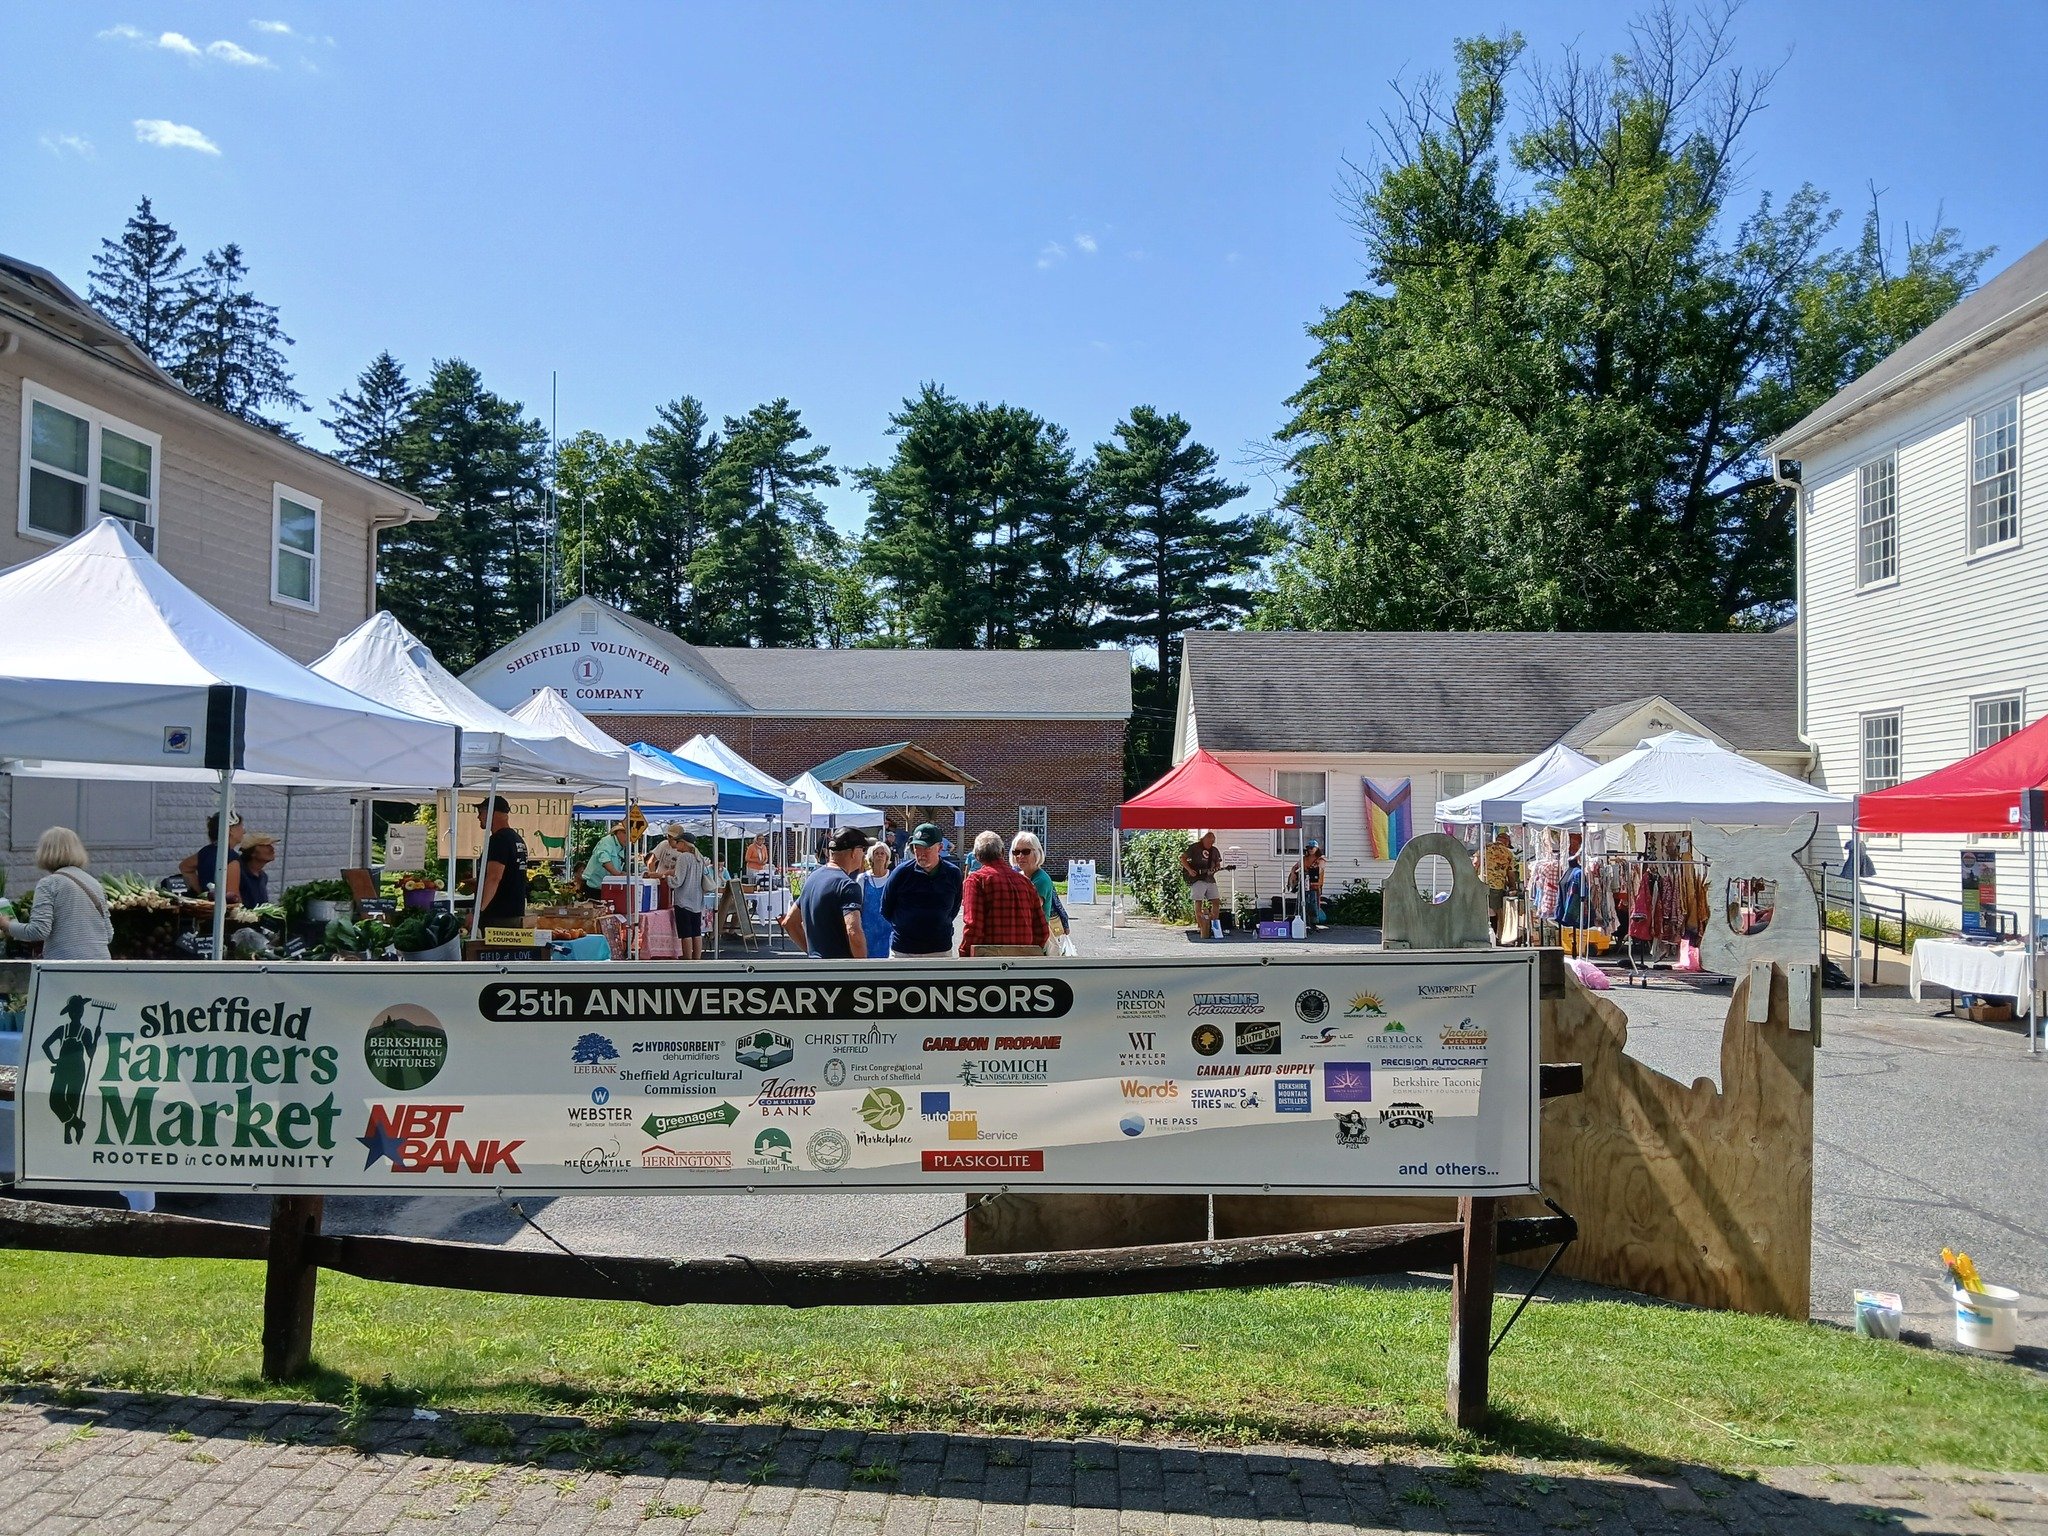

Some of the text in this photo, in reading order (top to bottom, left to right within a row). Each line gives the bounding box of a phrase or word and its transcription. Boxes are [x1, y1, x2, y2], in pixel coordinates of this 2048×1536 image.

[506, 641, 671, 676] SHEFFIELD VOLUNTEER
[582, 662, 592, 678] 1
[576, 688, 644, 700] COMPANY
[536, 798, 569, 816] Hill
[492, 930, 515, 938] SENIOR
[480, 952, 501, 961] FIELD
[514, 951, 532, 961] LOVE
[496, 984, 1056, 1017] 25th ANNIVERSARY SPONSORS
[1117, 990, 1165, 1000] SANDRA
[1193, 993, 1259, 1005] WATSON'S
[1117, 1000, 1166, 1010] PRESTON
[1188, 1003, 1266, 1017] Automotive
[140, 996, 312, 1042] Sheffield
[1439, 1024, 1488, 1040] Jacquier
[369, 1036, 443, 1050] BERKSHIRE
[737, 1035, 752, 1050] BIG
[774, 1034, 792, 1049] ELM
[804, 1033, 850, 1045] CHRIST
[922, 1035, 1062, 1052] CARLSON PROPANE
[1367, 1035, 1423, 1043] GREYLOCK
[370, 1047, 443, 1059] AGRICULTURAL
[832, 1046, 869, 1054] SHEFFIELD
[100, 1031, 340, 1085] Farmers
[374, 1056, 437, 1069] VENTURES
[662, 1053, 720, 1062] dehumidifiers
[1381, 1058, 1488, 1066] PRECISION AUTOCRAFT
[574, 1065, 617, 1075] LEE BANK
[869, 1063, 923, 1073] Congregational
[978, 1060, 1048, 1073] TOMICH
[1197, 1063, 1316, 1076] CANAAN AUTO SUPPLY
[619, 1069, 743, 1083] Sheffield Agricultural
[853, 1072, 921, 1082] Church of Sheffield
[980, 1073, 1047, 1081] LANDSCAPE DESIGN
[1392, 1076, 1481, 1087] Berkshire Taconic
[644, 1084, 717, 1095] Commission
[749, 1077, 817, 1105] Adams
[1120, 1079, 1179, 1098] Ward's
[1191, 1088, 1247, 1098] SEWARD'S
[594, 1091, 607, 1103] W
[1278, 1097, 1308, 1105] DISTILLERS
[1191, 1099, 1222, 1109] TIRES
[94, 1085, 342, 1150] Market
[567, 1108, 633, 1121] WEBSTER
[762, 1106, 812, 1117] BANK
[921, 1110, 978, 1122] autobahn
[1379, 1109, 1434, 1125] MAHAIWE
[364, 1104, 465, 1140] NBT
[656, 1109, 725, 1132] greenagers
[1149, 1117, 1199, 1125] THE PASS
[1391, 1118, 1423, 1126] TENT
[856, 1133, 913, 1147] Marketplace
[977, 1130, 1018, 1140] Service
[93, 1151, 335, 1169] ROOTED in COMMUNITY
[391, 1139, 527, 1174] BANK
[747, 1158, 778, 1166] Sheffield
[934, 1155, 1031, 1167] PLASKOLITE
[564, 1160, 632, 1168] MERCANTILE
[763, 1163, 780, 1174] Land
[1398, 1163, 1500, 1176] and others...
